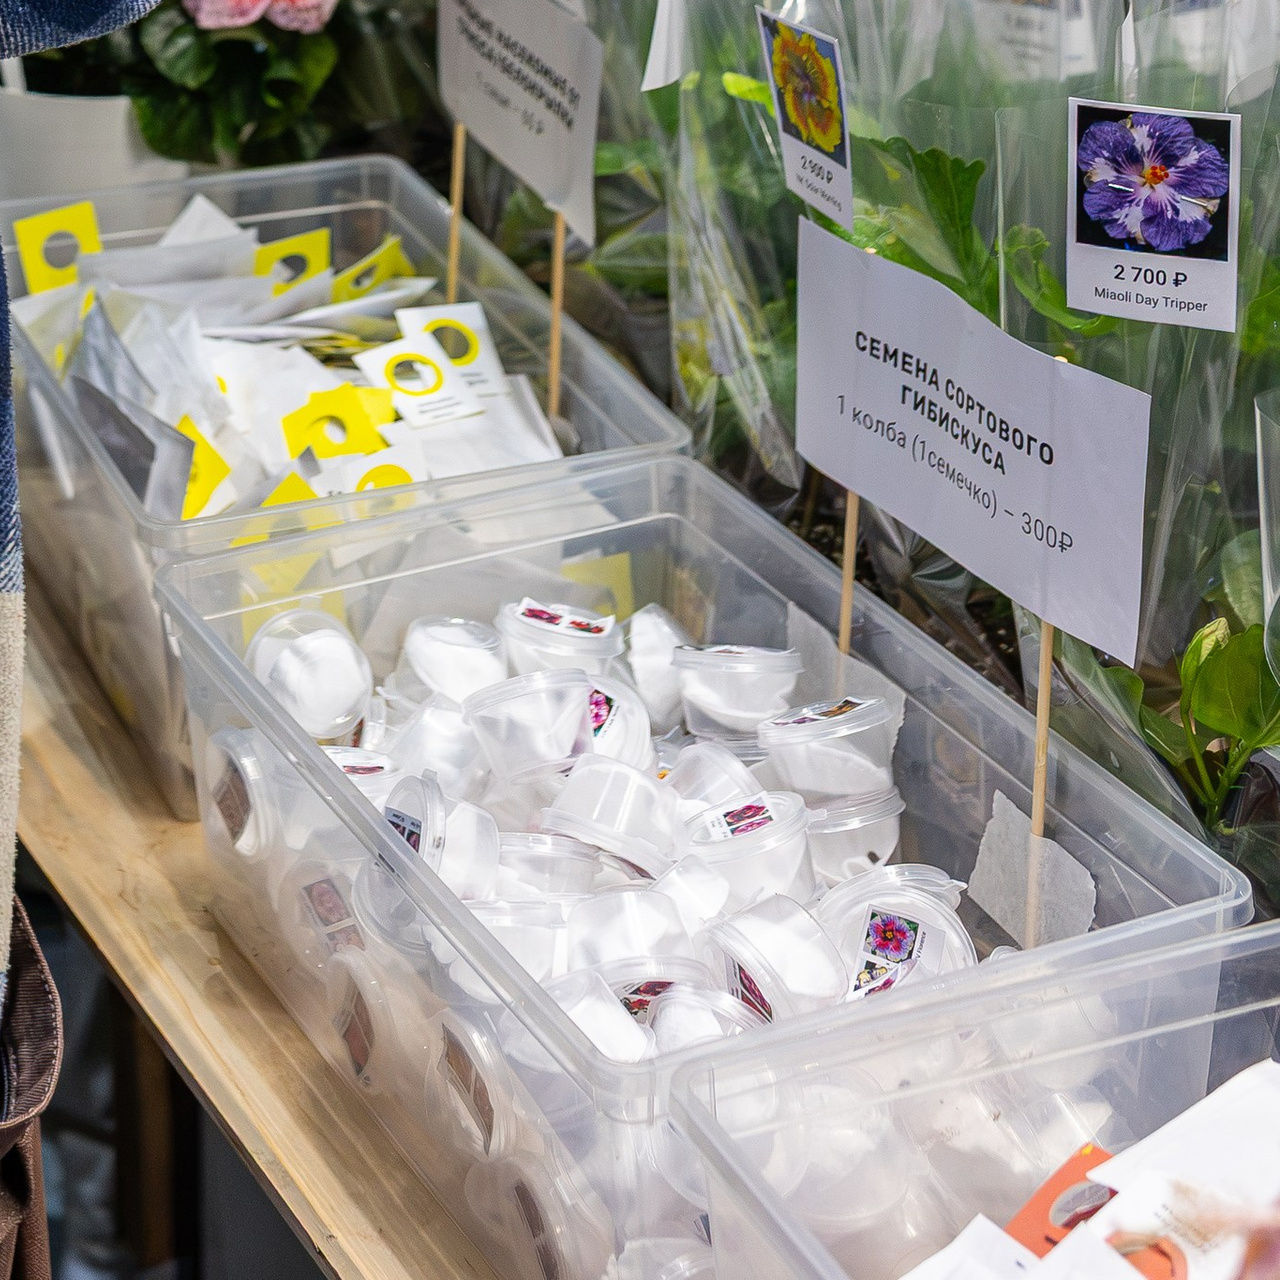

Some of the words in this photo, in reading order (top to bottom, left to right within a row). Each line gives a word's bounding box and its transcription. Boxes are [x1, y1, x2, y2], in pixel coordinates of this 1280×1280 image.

[1094, 286, 1132, 303] Miaoli
[1135, 292, 1159, 309] Day
[1162, 296, 1208, 313] Tripper
[1113, 264, 1126, 281] 2
[1130, 266, 1167, 286] 700
[1172, 271, 1188, 288] ₽
[854, 330, 940, 392] СЕМЕНА
[944, 378, 1055, 466] СОРТОВОГО
[900, 384, 1007, 476] ГИБИСКУСА
[837, 394, 846, 416] 1
[851, 405, 907, 449] колба
[1021, 512, 1074, 554] 300₽
